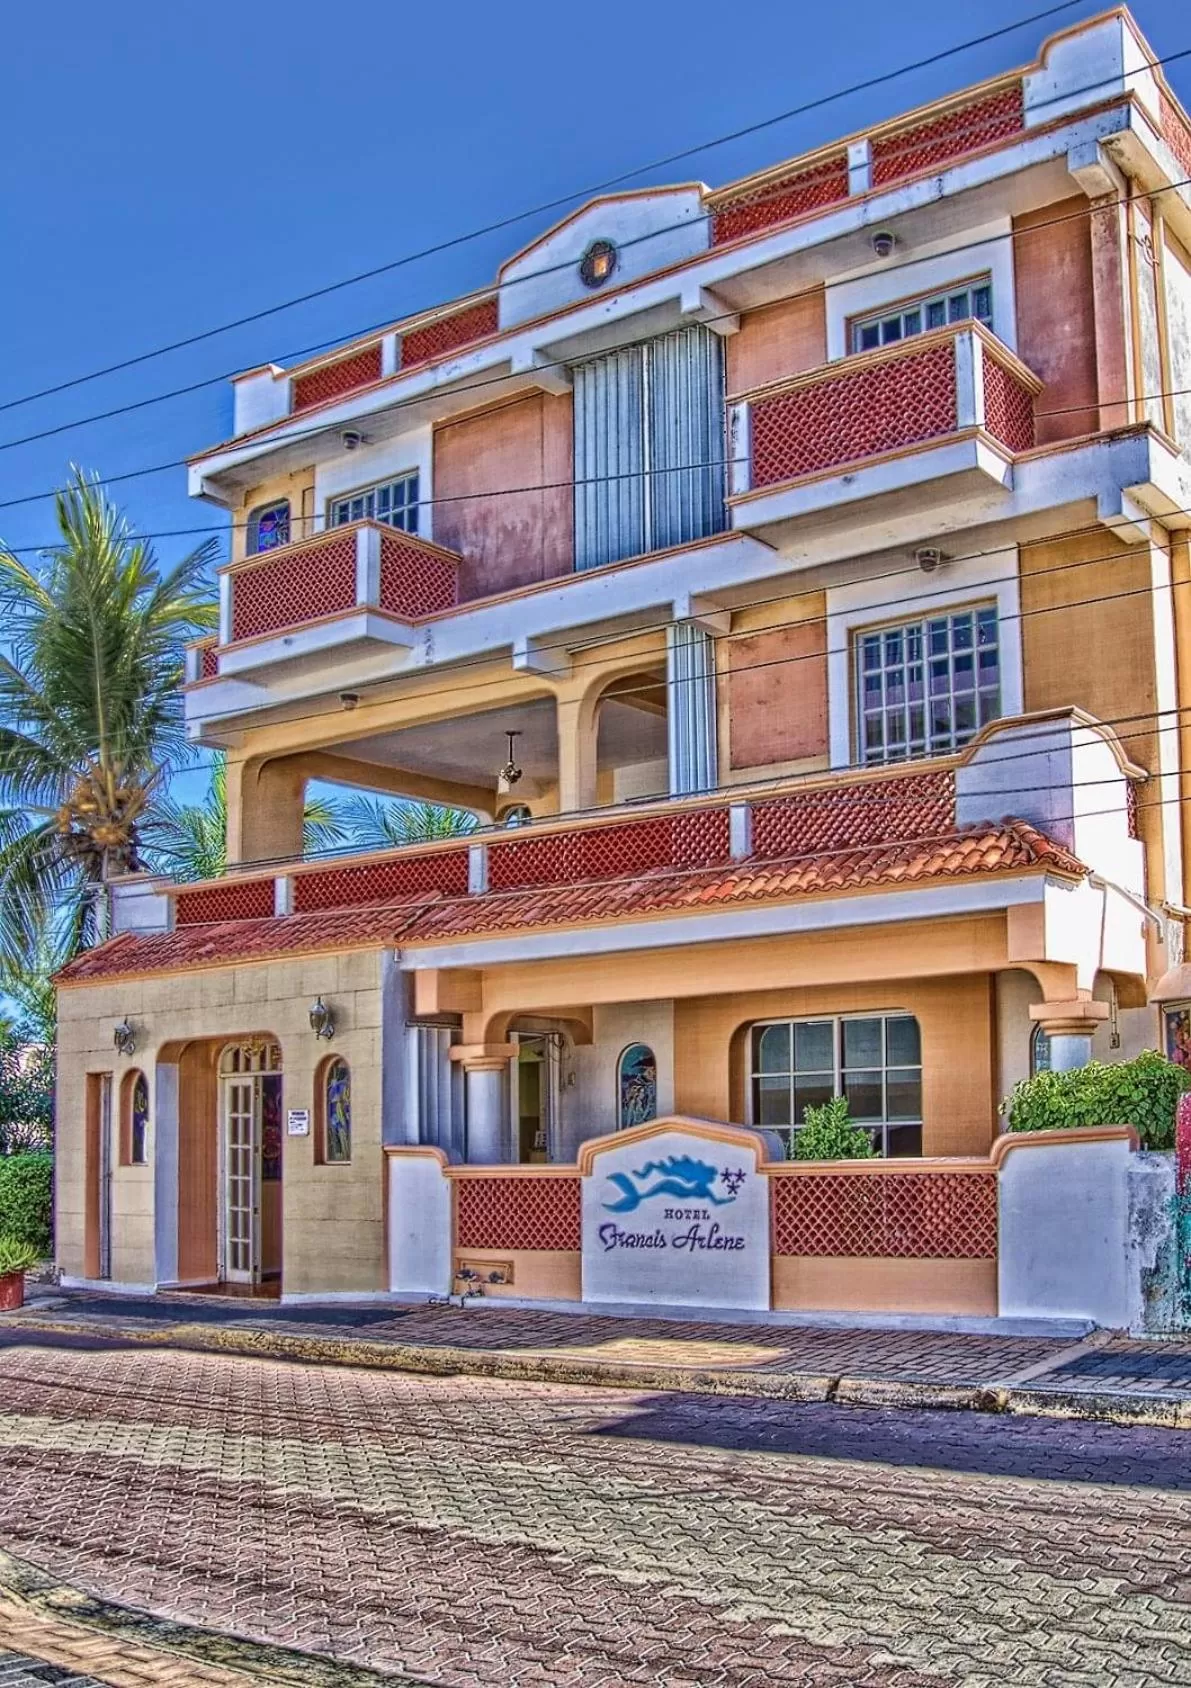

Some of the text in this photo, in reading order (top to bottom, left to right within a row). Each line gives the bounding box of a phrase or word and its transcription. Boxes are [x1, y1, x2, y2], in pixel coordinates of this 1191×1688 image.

[663, 1208, 711, 1220] HOTEL
[599, 1222, 745, 1252] Francis Arlene
